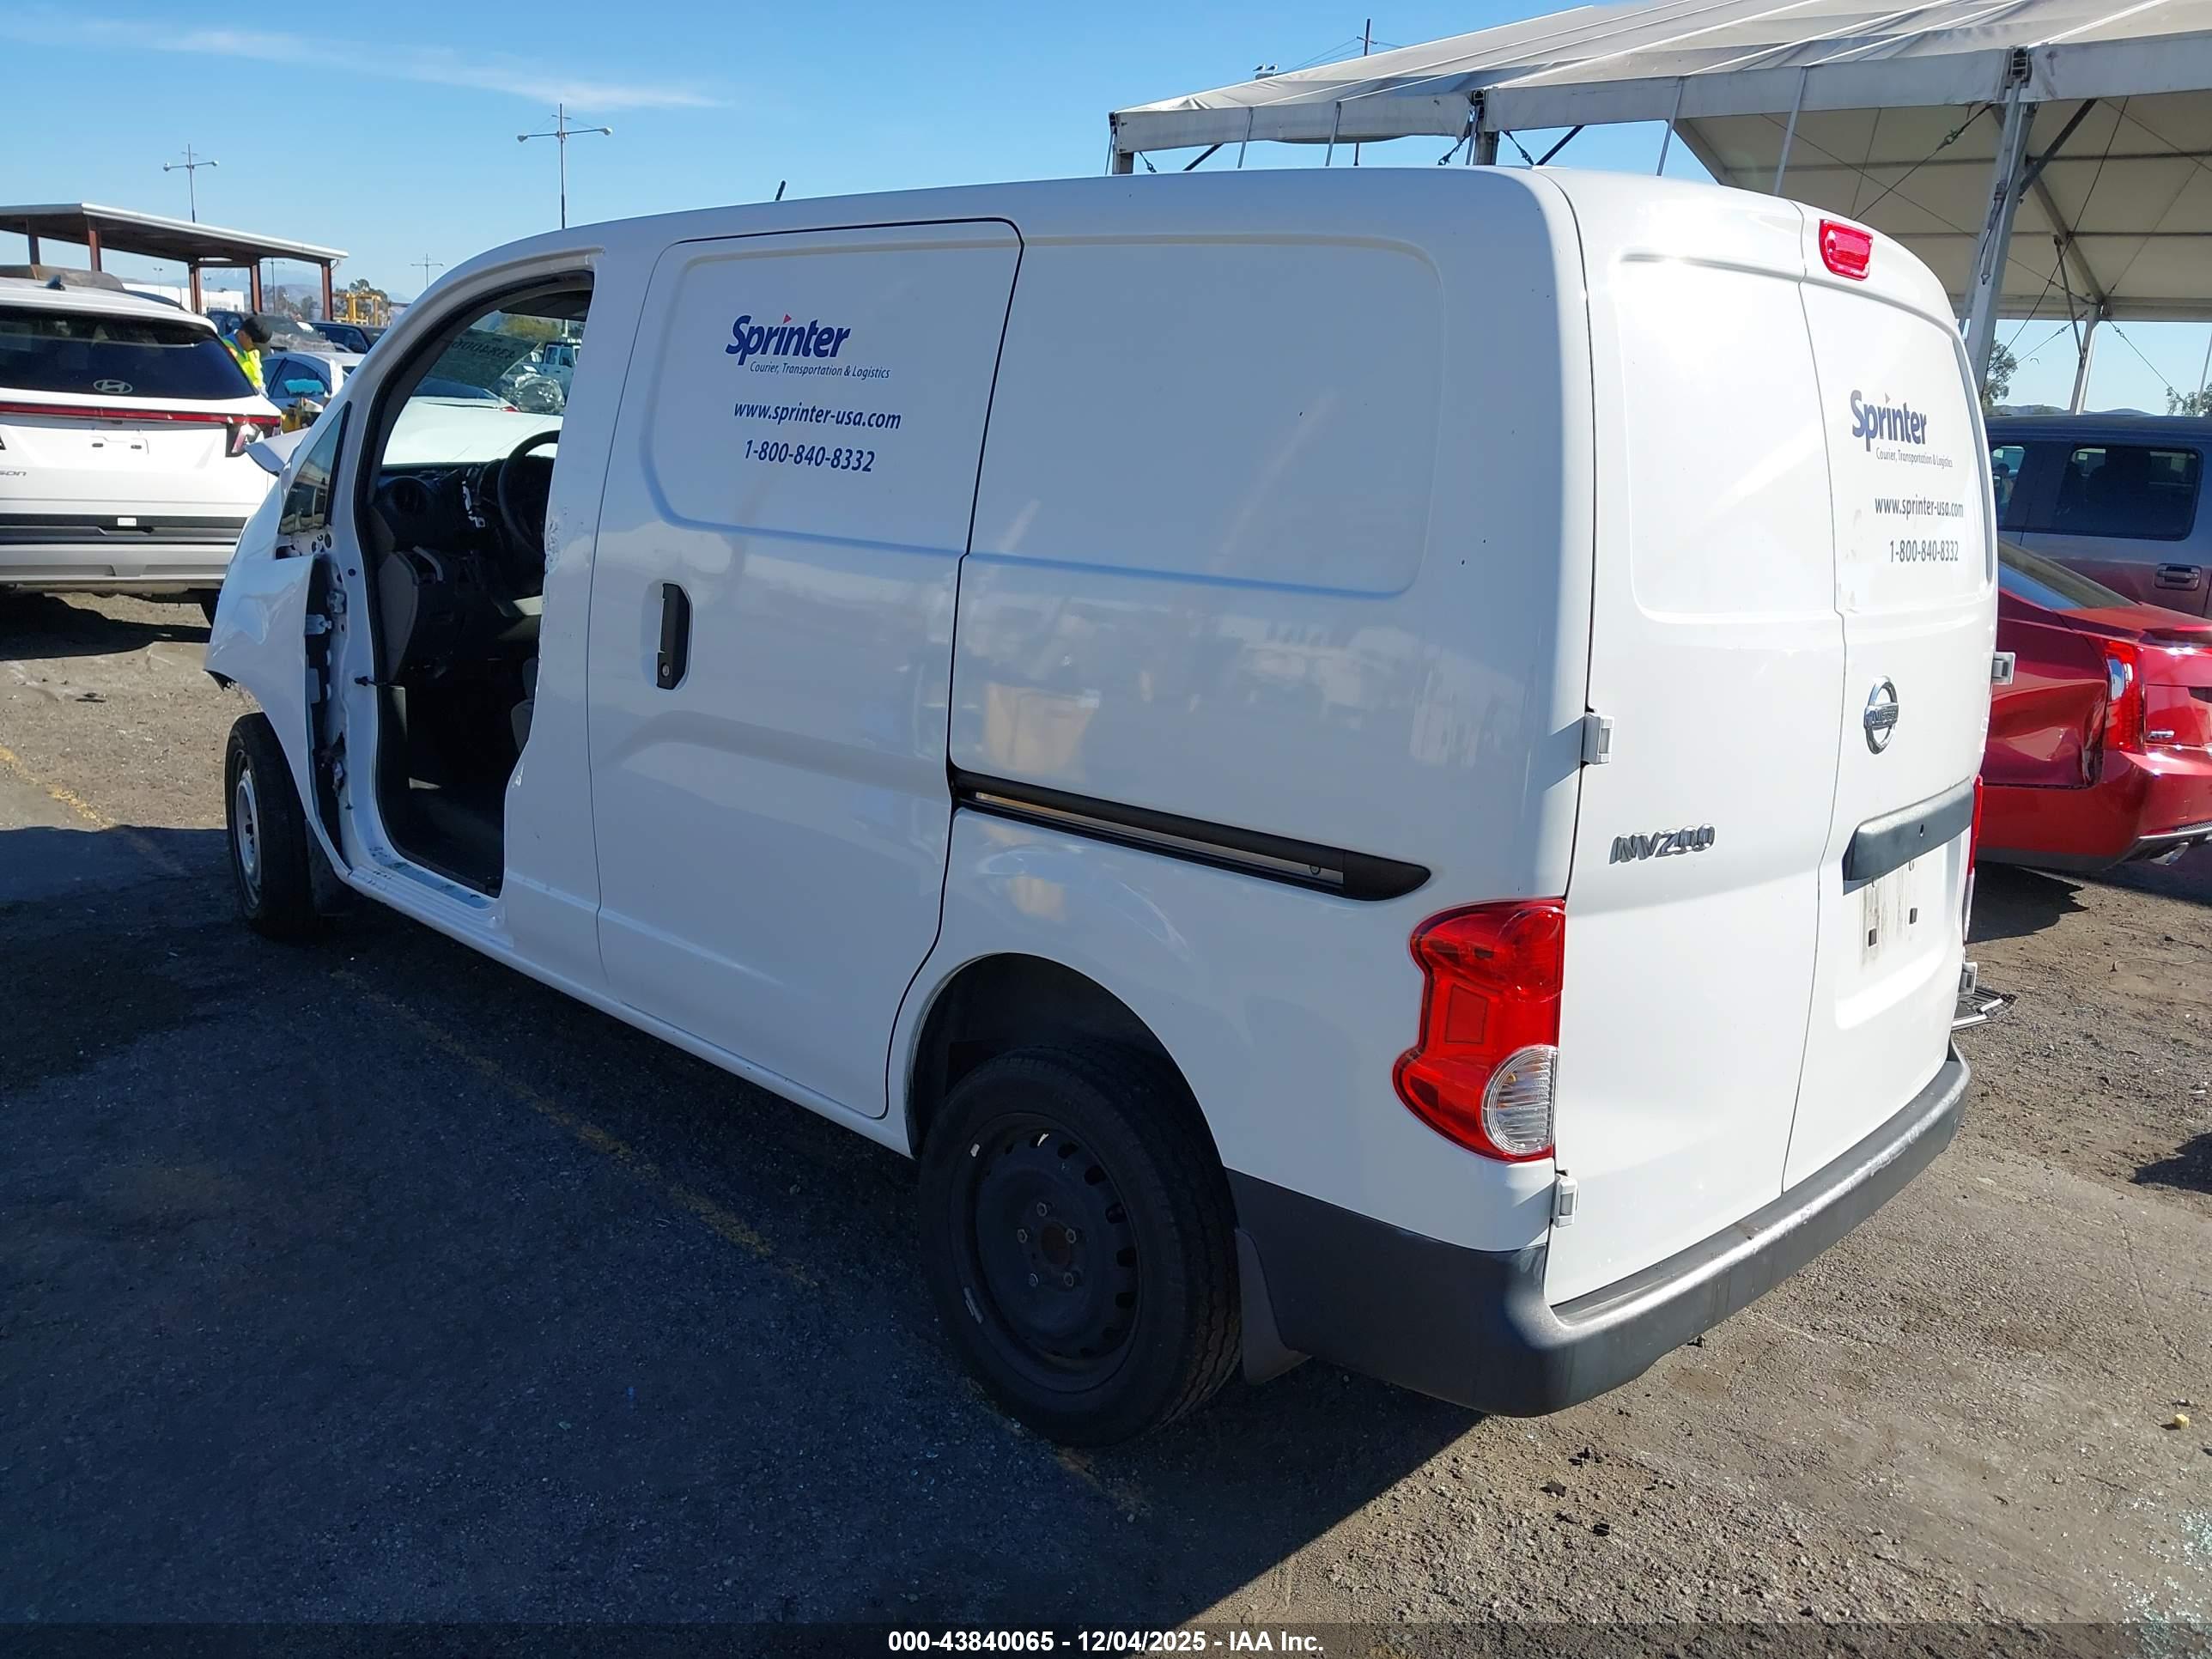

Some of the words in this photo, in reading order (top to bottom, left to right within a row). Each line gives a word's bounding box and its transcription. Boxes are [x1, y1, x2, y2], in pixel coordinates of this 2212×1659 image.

[726, 314, 851, 365] Sprinter
[750, 361, 780, 374] Courier,
[782, 362, 842, 376] Transportation
[843, 366, 850, 376] &
[852, 365, 890, 380] Logistics
[734, 402, 902, 429] www.sprinter-usa.com
[1850, 389, 1927, 452] Sprinter
[744, 439, 875, 472] 1-800-840-8332
[1876, 447, 1897, 463] Courier,
[1898, 449, 1932, 465] Transportation
[1875, 495, 1964, 520] www.sprinter-usa.com
[1890, 539, 1959, 562] 1-800-840-8332
[1608, 823, 1716, 865] NV200
